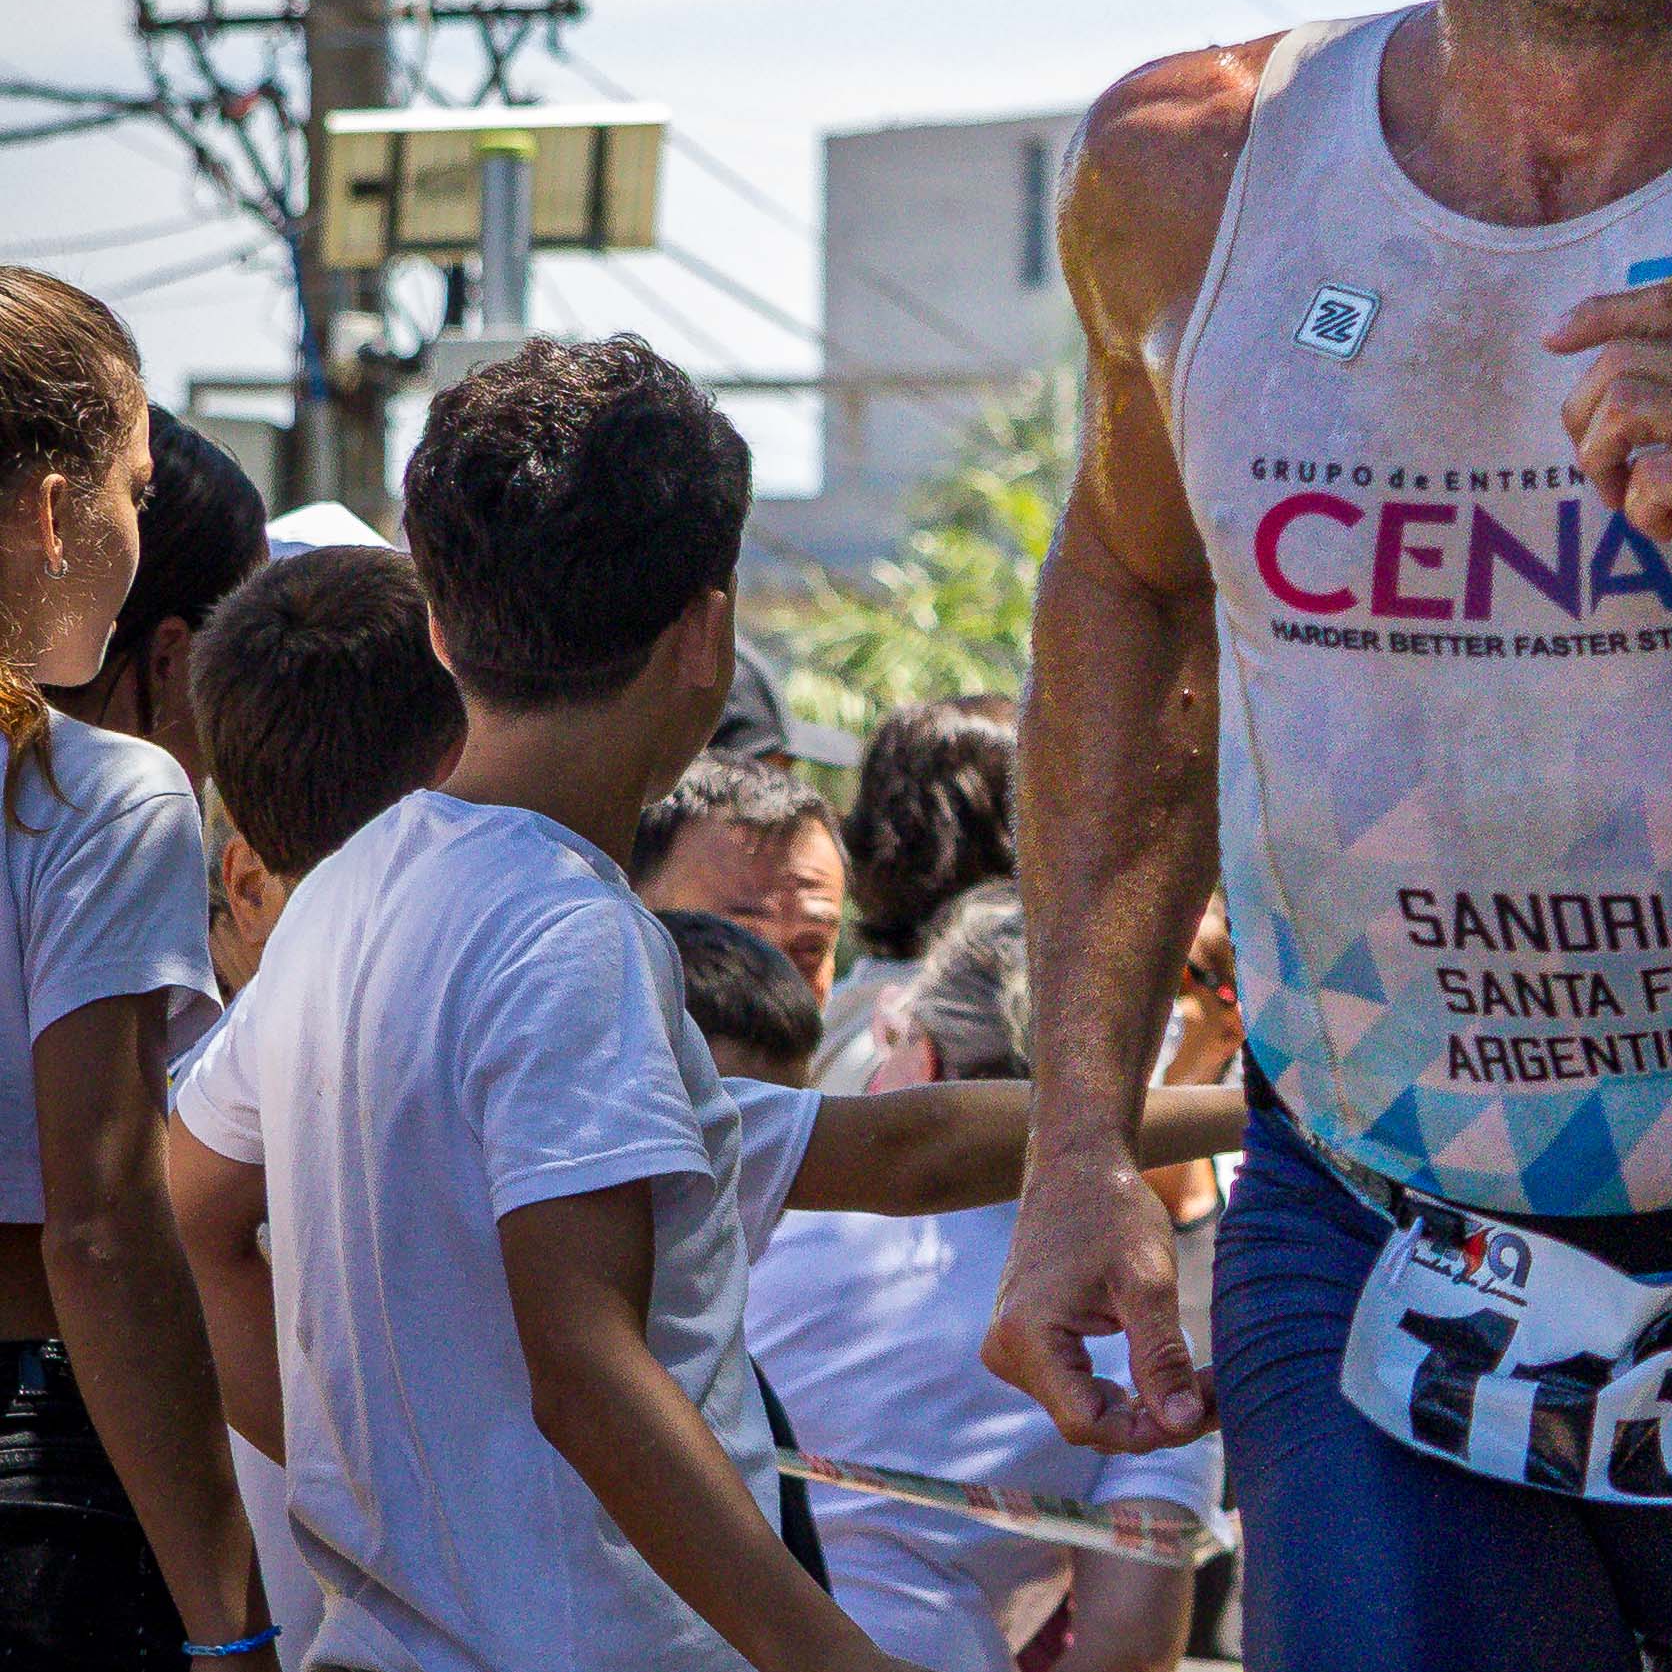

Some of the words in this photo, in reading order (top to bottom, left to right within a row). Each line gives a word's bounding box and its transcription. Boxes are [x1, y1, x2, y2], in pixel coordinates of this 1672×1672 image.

[1251, 457, 1374, 488] GRUPO
[1268, 620, 1378, 653] HARDER
[1389, 630, 1505, 658] BETTER
[1514, 631, 1628, 658] FASTER
[1437, 967, 1626, 1019] SANTA
